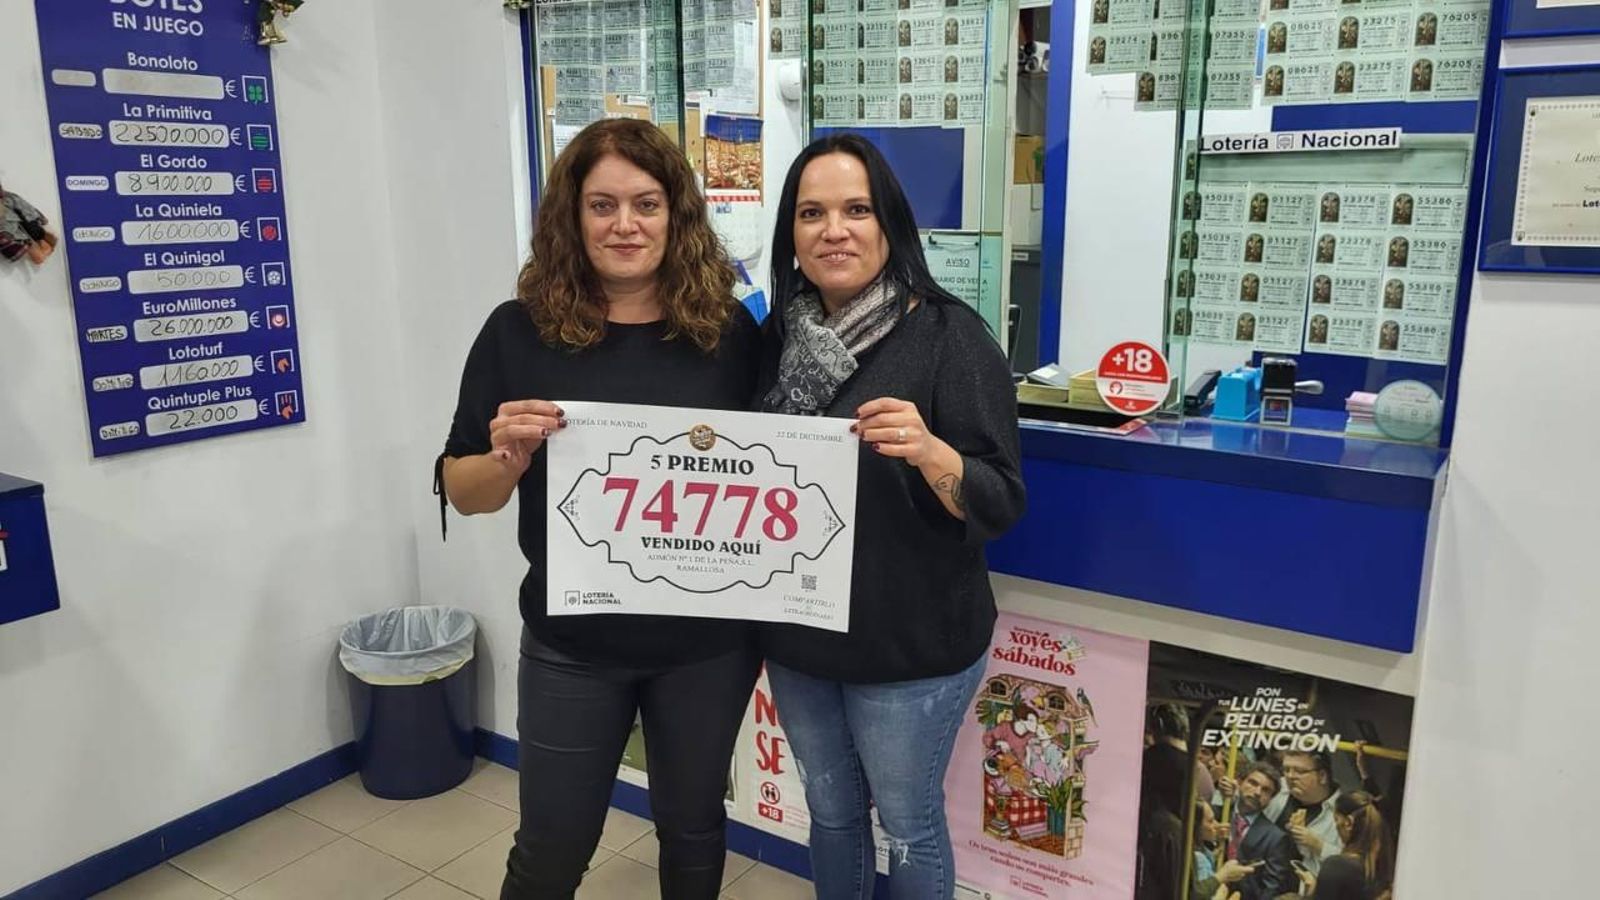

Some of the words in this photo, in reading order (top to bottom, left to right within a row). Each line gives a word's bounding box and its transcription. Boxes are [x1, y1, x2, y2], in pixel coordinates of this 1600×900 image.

[112, 12, 137, 29] EN
[143, 15, 204, 36] JUEGO
[127, 52, 198, 71] Bonoloto
[224, 79, 237, 98] €
[123, 102, 141, 118] La
[146, 104, 212, 120] Primitiva
[230, 128, 242, 146] €
[1200, 134, 1269, 151] Lotería
[1301, 130, 1397, 148] Nacional
[140, 154, 153, 168] El
[157, 154, 207, 169] Gordo
[235, 174, 247, 192] €
[135, 203, 153, 217] La
[158, 203, 222, 218] Quiniela
[240, 221, 251, 238] €
[144, 252, 157, 266] El
[161, 249, 225, 266] Quinigol
[245, 266, 256, 284] €
[142, 297, 237, 315] EuroMillones
[250, 311, 262, 328] €
[169, 341, 224, 360] Lototurf
[254, 355, 265, 372] €
[1112, 348, 1153, 373] +18
[147, 389, 221, 410] Quintuple
[225, 386, 252, 399] Plus
[258, 398, 270, 415] €
[567, 418, 595, 427] OTERÍA
[610, 420, 647, 428] NAVIDAD
[668, 455, 754, 475] PREMIO
[603, 477, 798, 541] 74778
[641, 536, 715, 552] VENDIDO
[719, 540, 762, 556] AQUÍ
[993, 646, 1076, 676] sábados
[1256, 688, 1281, 697] PON
[756, 687, 781, 727] N
[1230, 696, 1298, 713] LUNES
[1224, 713, 1313, 731] PELIGRO
[1202, 727, 1340, 753] EXTINCIÓN
[756, 731, 785, 775] SE
